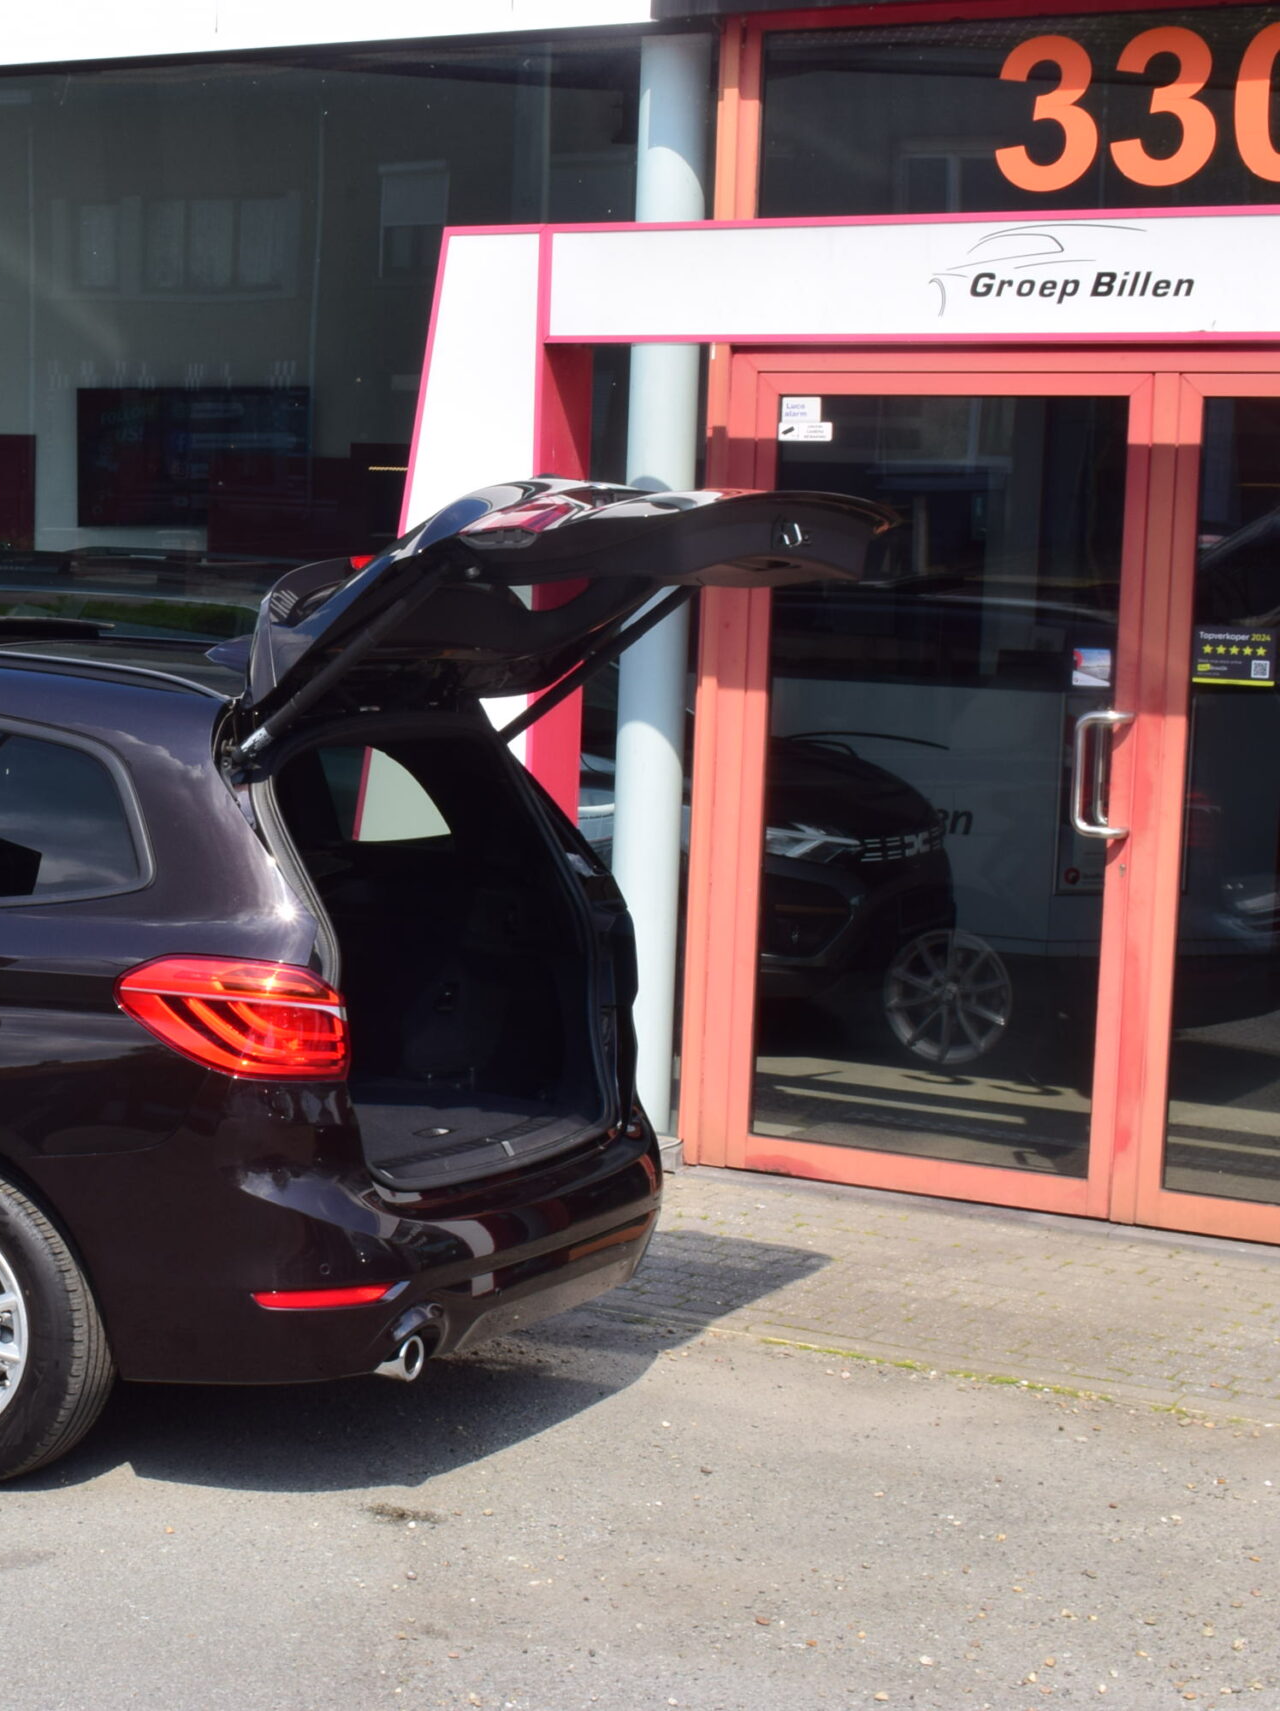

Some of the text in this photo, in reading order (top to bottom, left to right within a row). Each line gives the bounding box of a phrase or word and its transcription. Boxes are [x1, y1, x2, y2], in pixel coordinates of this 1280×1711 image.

[969, 270, 1195, 304] Groep Billen
[1199, 631, 1250, 642] Topverkoper
